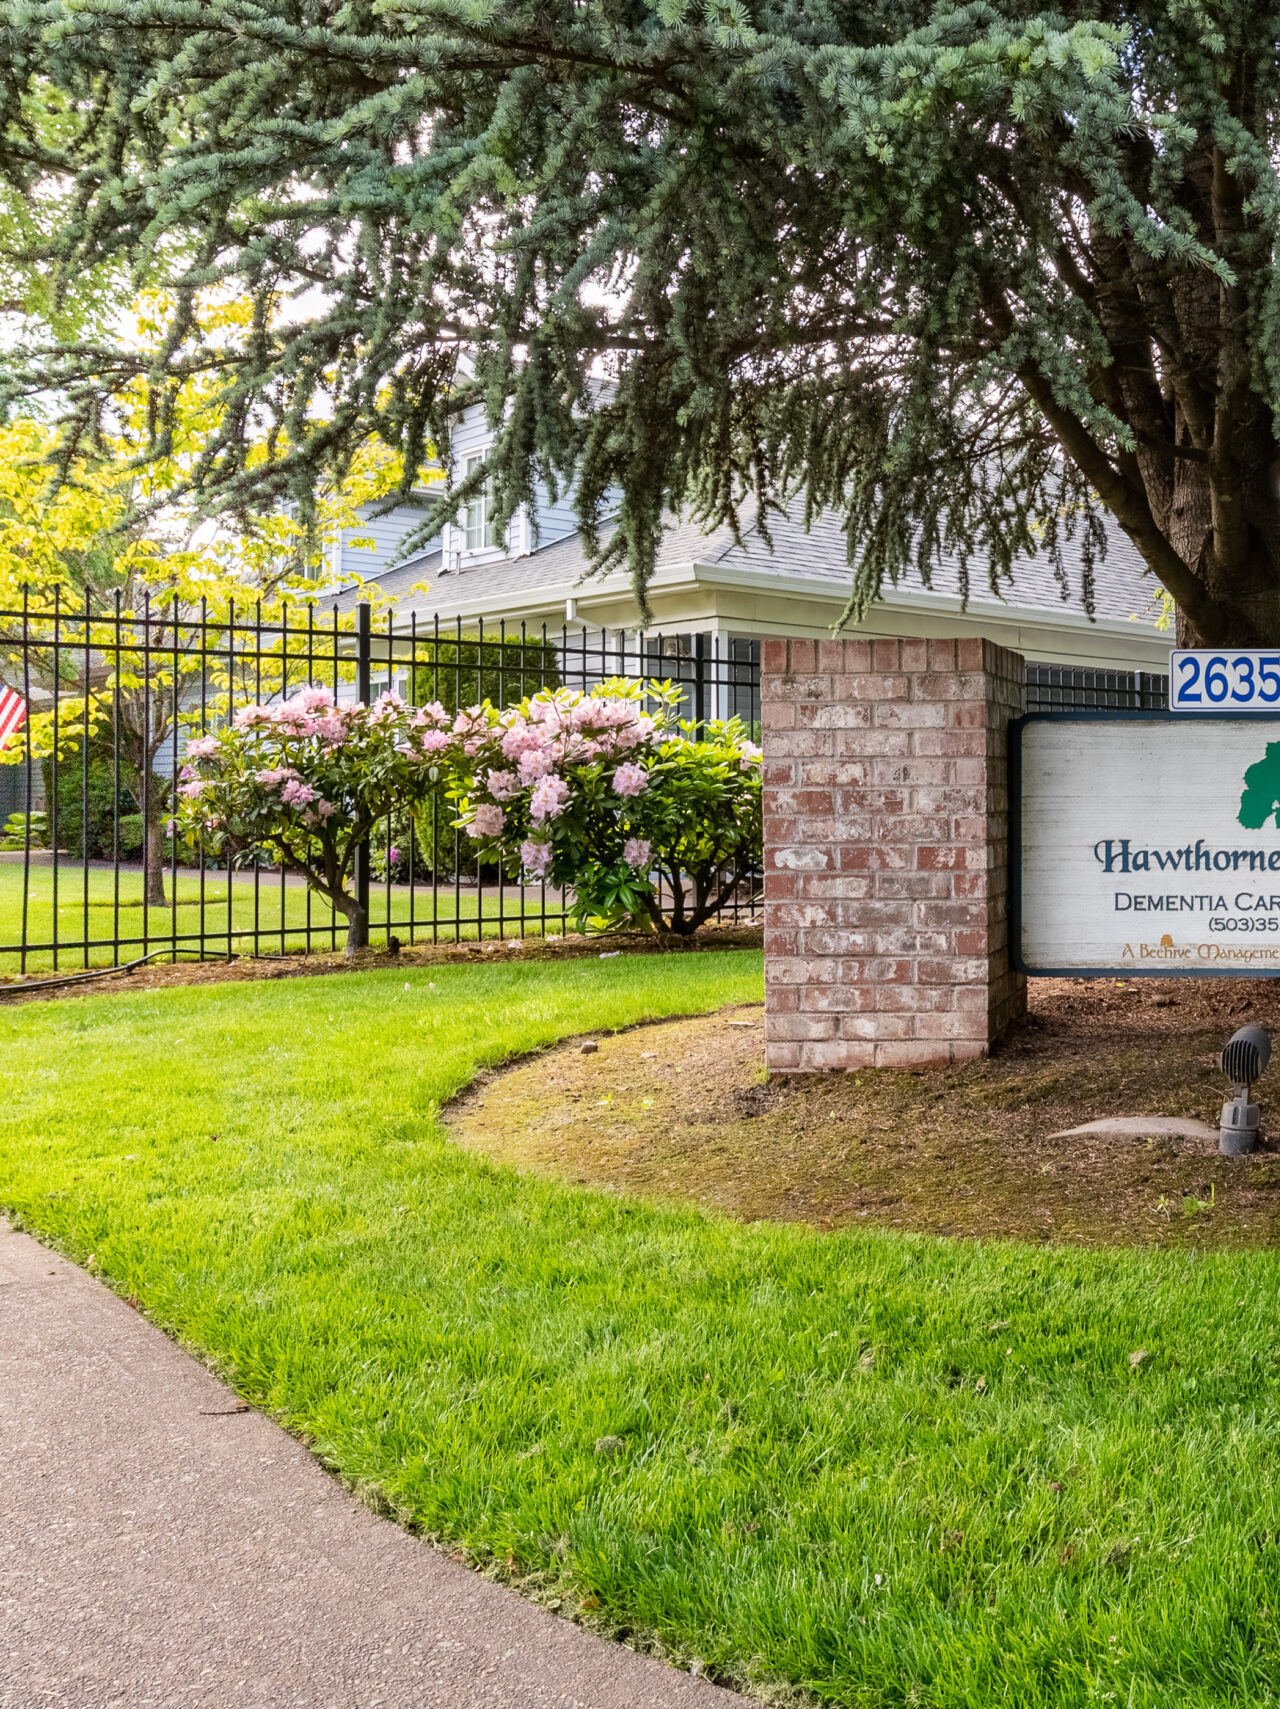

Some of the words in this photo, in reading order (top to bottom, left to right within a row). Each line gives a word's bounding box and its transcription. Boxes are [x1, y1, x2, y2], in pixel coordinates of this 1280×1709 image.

[1114, 892, 1228, 911] DEMENTIA
[1122, 943, 1135, 959] A
[1140, 943, 1192, 959] Beehive
